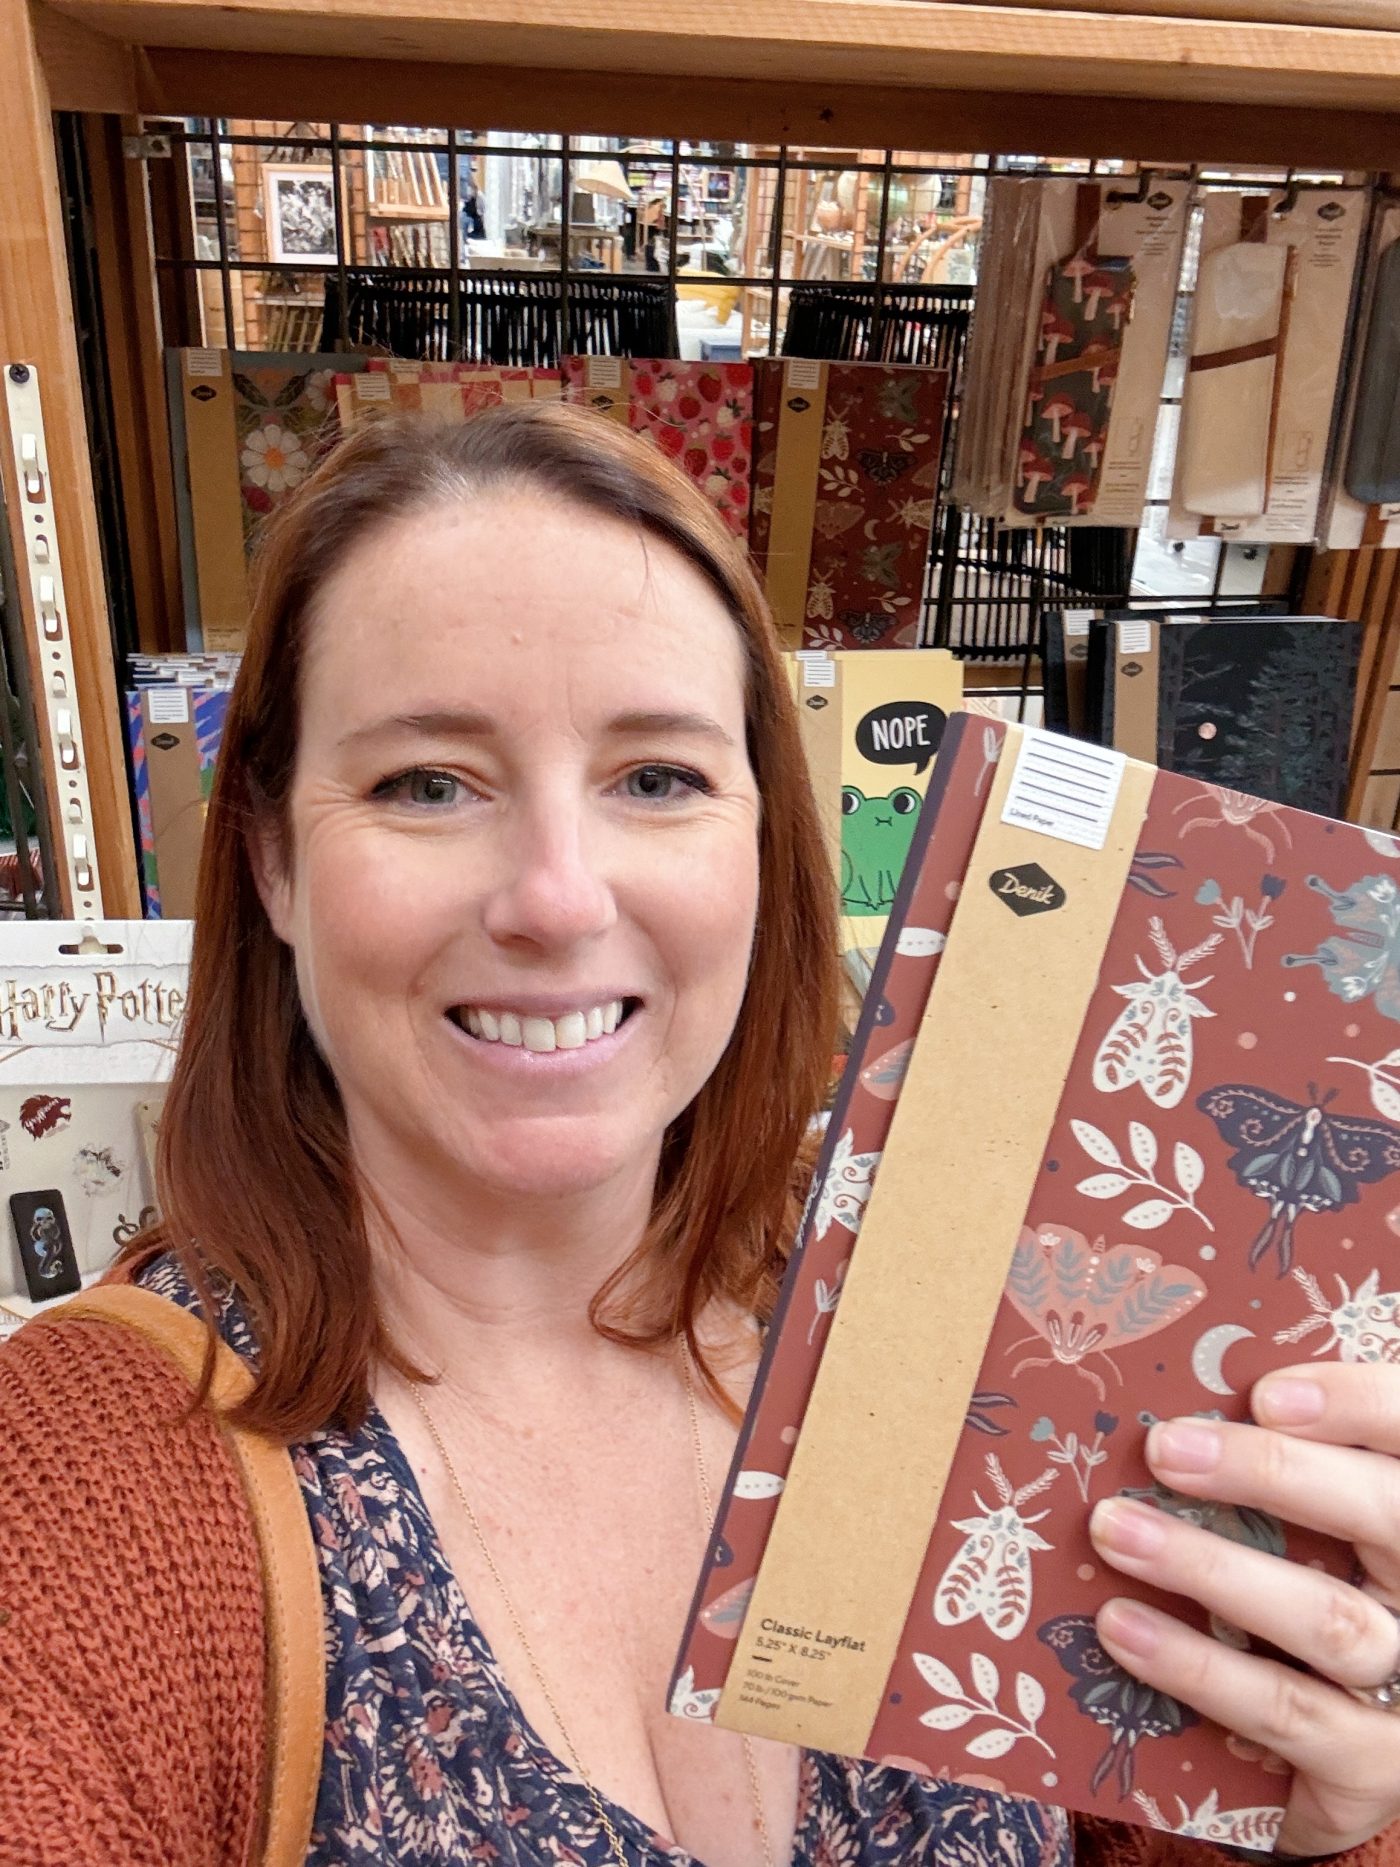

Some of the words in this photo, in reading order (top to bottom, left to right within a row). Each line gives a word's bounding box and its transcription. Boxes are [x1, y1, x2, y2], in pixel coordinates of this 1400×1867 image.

[871, 714, 931, 751] NOPE
[999, 872, 1055, 905] Denik
[0, 980, 91, 1040] Harry
[93, 972, 186, 1043] Potte
[756, 1636, 787, 1651] 5.25"
[788, 1644, 797, 1655] X
[800, 1646, 832, 1661] 8.25"
[761, 1618, 813, 1641] Classic
[815, 1630, 866, 1652] Layflat
[775, 1675, 801, 1687] Cover
